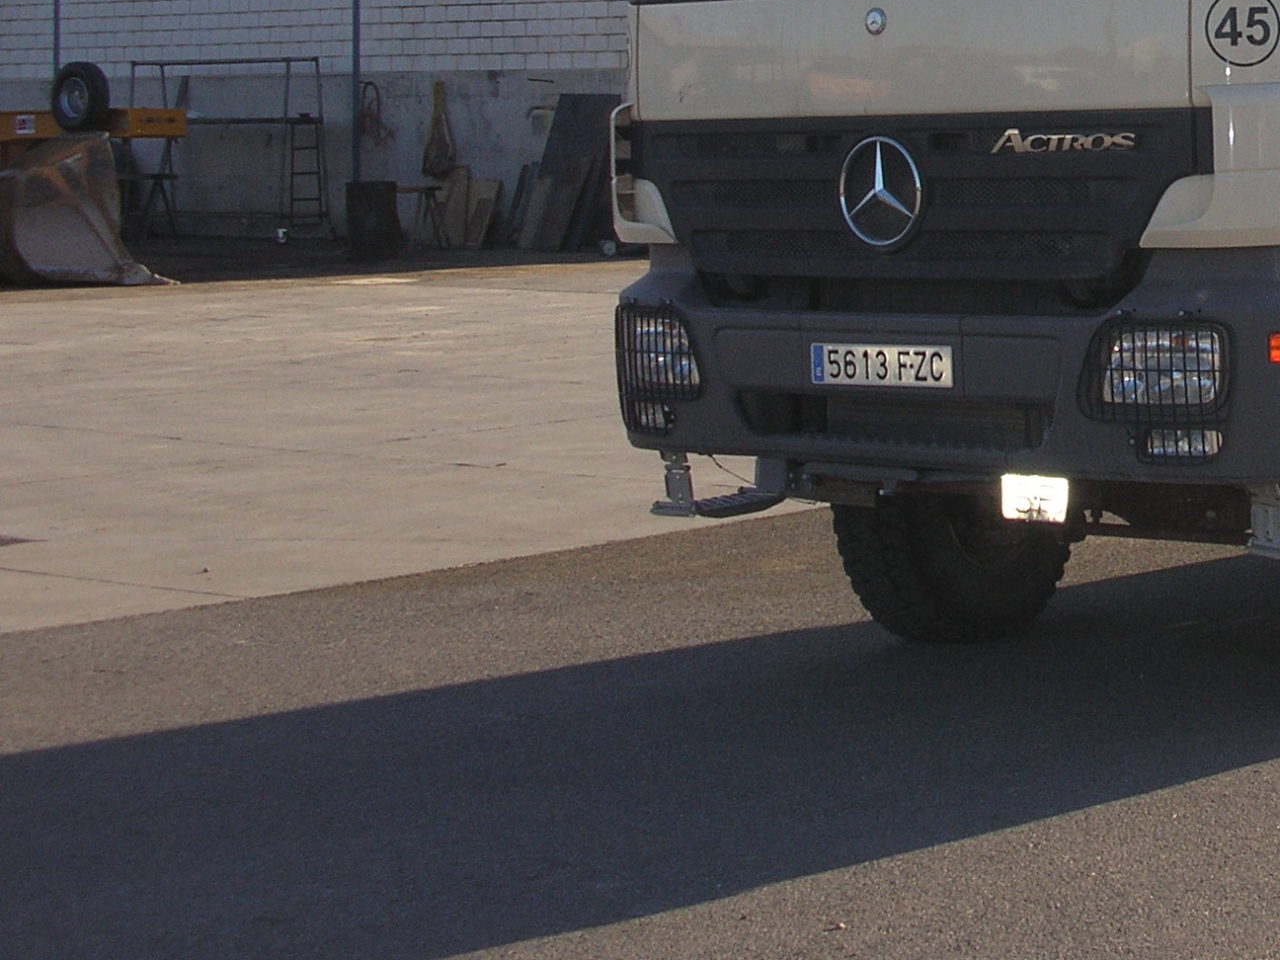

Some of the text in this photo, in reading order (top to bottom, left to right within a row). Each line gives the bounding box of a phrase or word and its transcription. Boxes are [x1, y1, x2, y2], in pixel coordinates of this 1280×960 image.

[1213, 5, 1271, 47] 45
[827, 349, 944, 382] 5613 FZC
